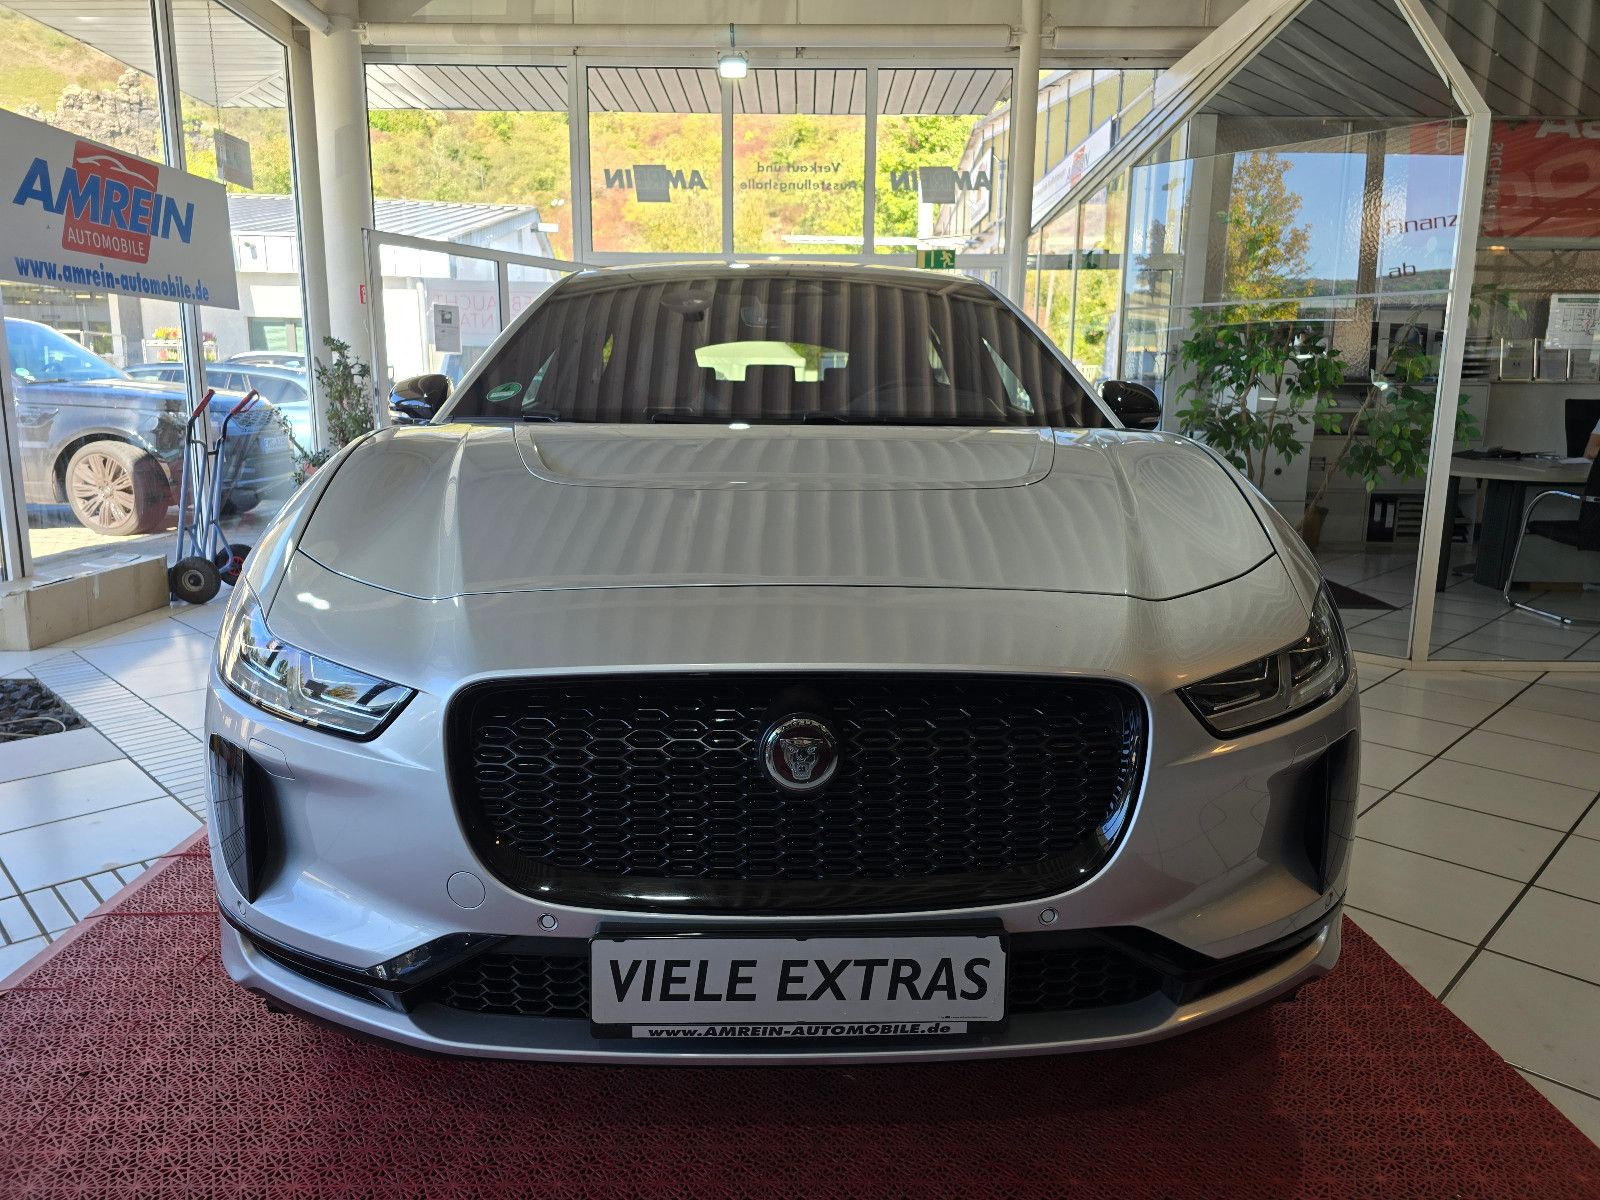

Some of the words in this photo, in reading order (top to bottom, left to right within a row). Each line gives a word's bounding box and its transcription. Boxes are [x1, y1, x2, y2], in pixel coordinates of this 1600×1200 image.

[12, 157, 195, 244] AMREIN
[67, 226, 146, 257] AUTOMOBILE
[14, 256, 210, 300] www.amrein-automobile.de
[609, 959, 758, 1003] VIELE
[776, 957, 991, 1002] EXTRAS
[647, 1022, 952, 1037] www.AMREIN-AUTOMOBILE.de
